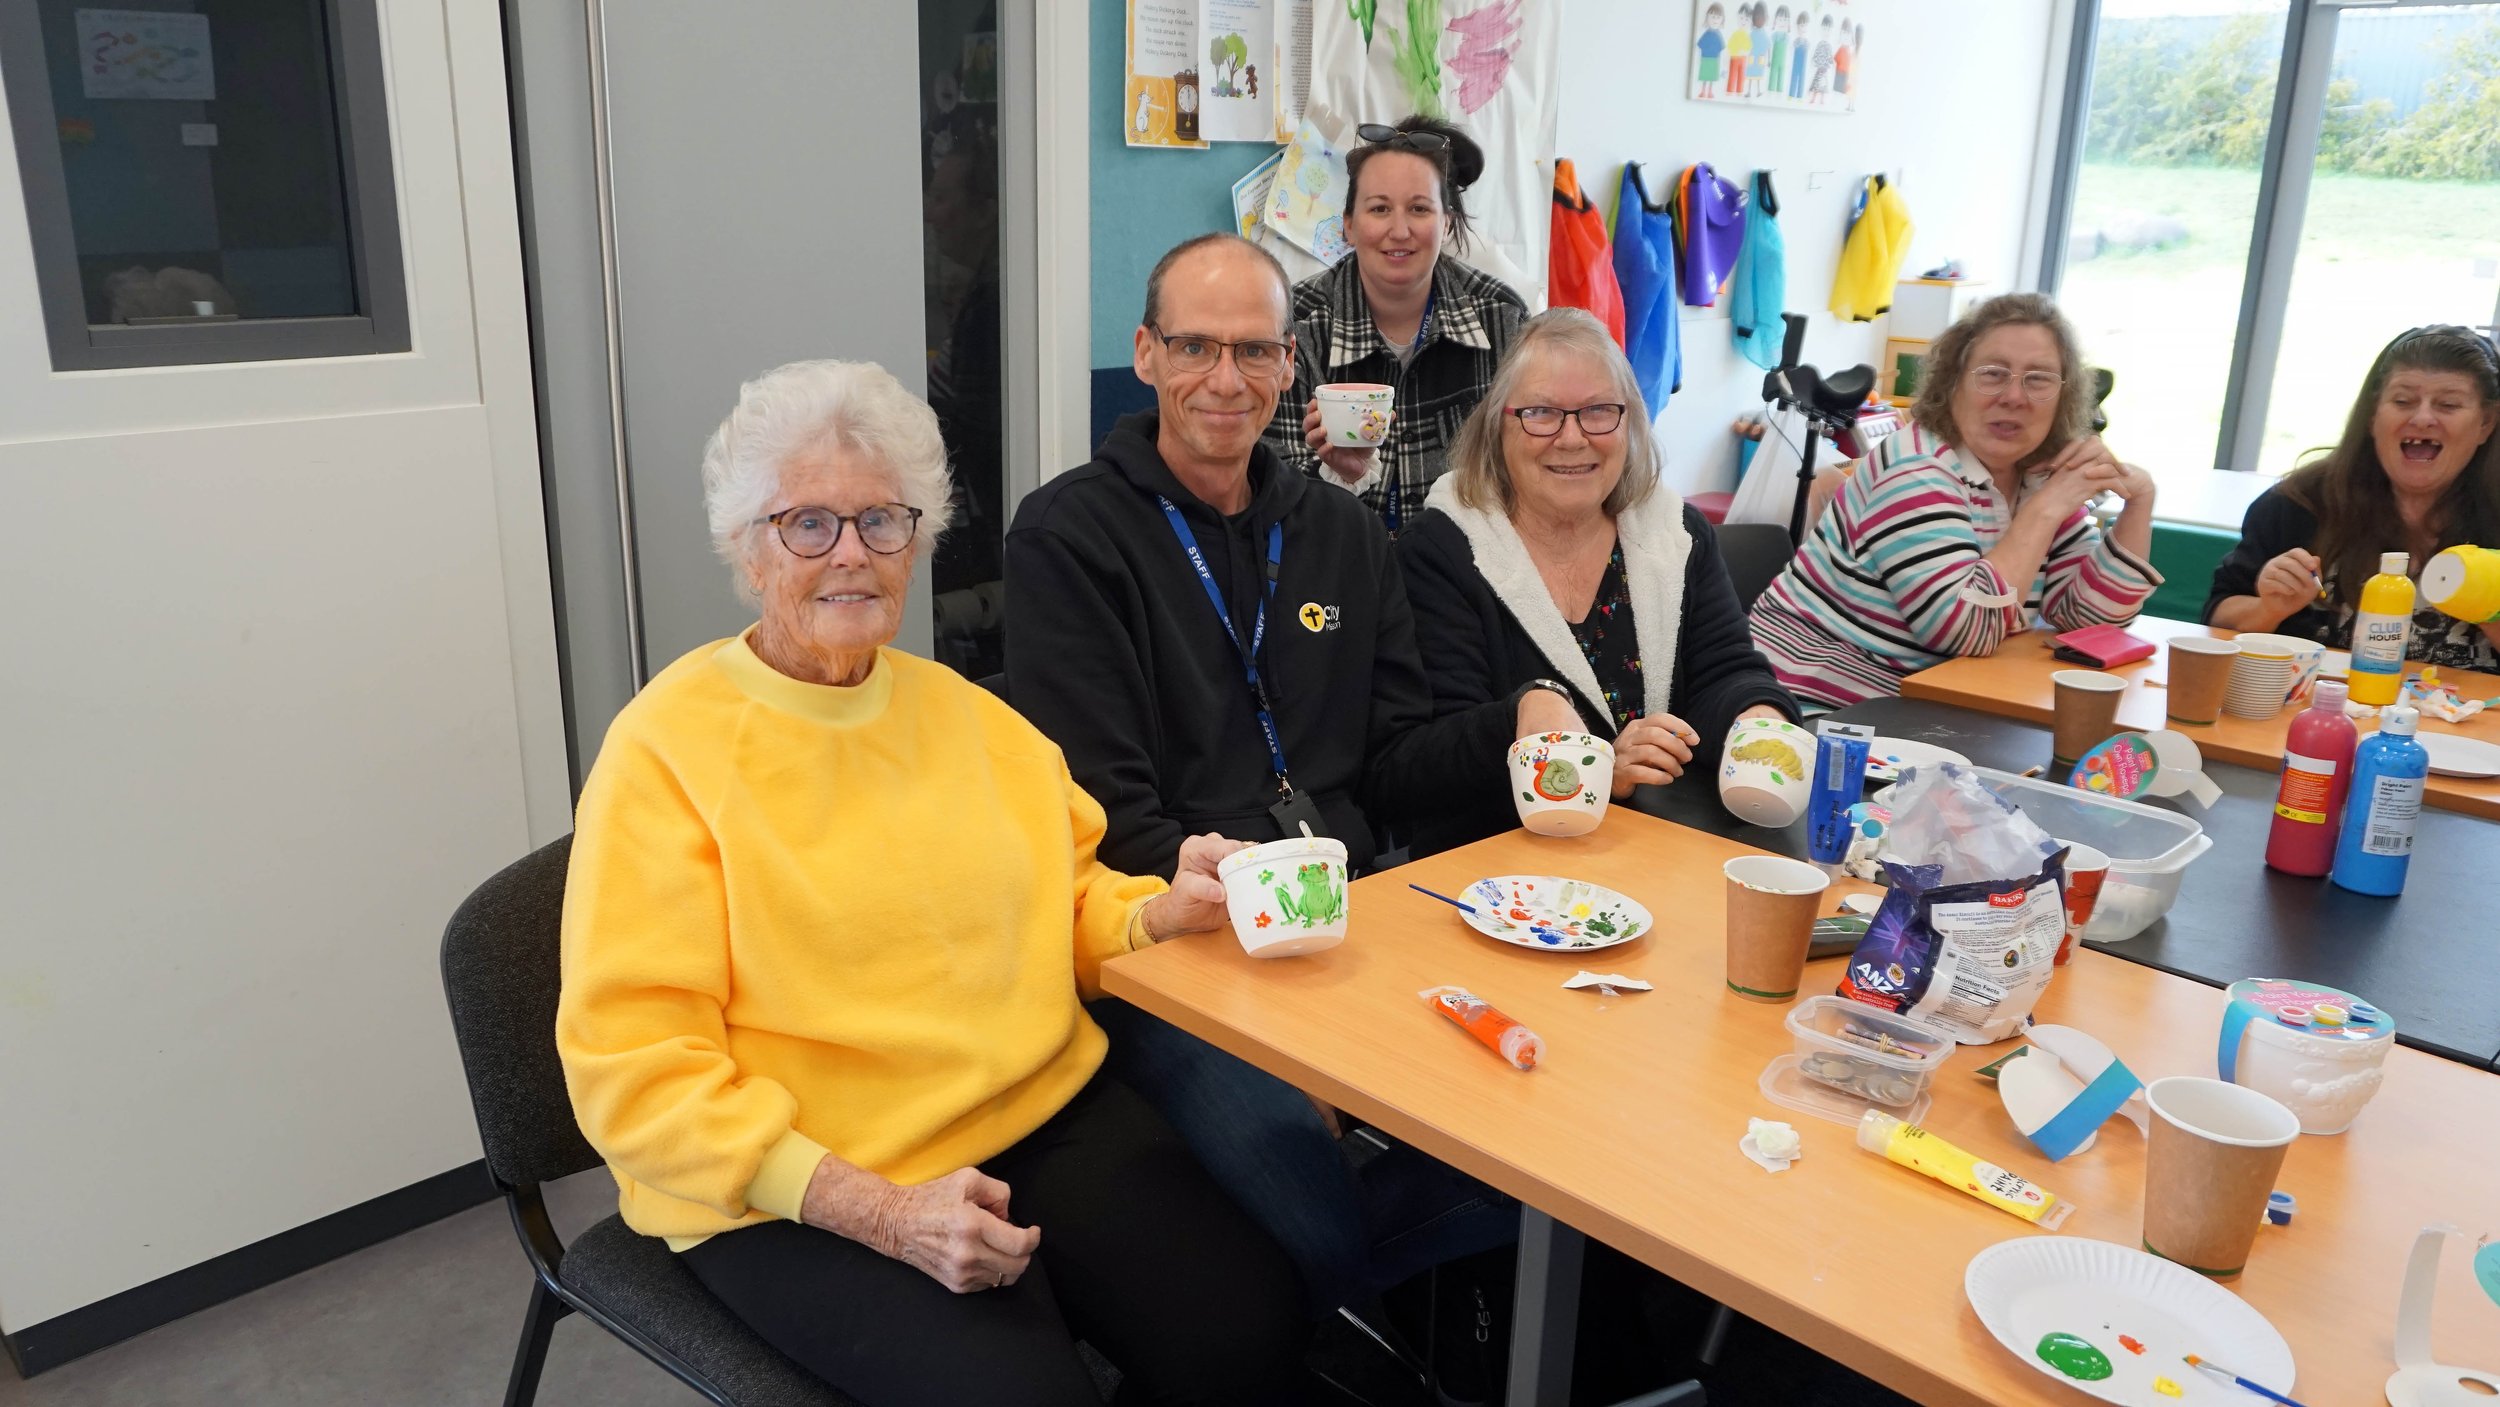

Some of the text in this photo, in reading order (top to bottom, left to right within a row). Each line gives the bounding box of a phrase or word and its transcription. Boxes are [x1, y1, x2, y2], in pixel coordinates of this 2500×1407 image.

[1188, 546, 1211, 580] STAFF
[1324, 604, 1340, 621] City
[2369, 622, 2402, 634] CLUB
[2369, 633, 2402, 642] HOUSE
[1261, 720, 1278, 754] STAFF
[1955, 975, 2000, 995] Nutrition Facts
